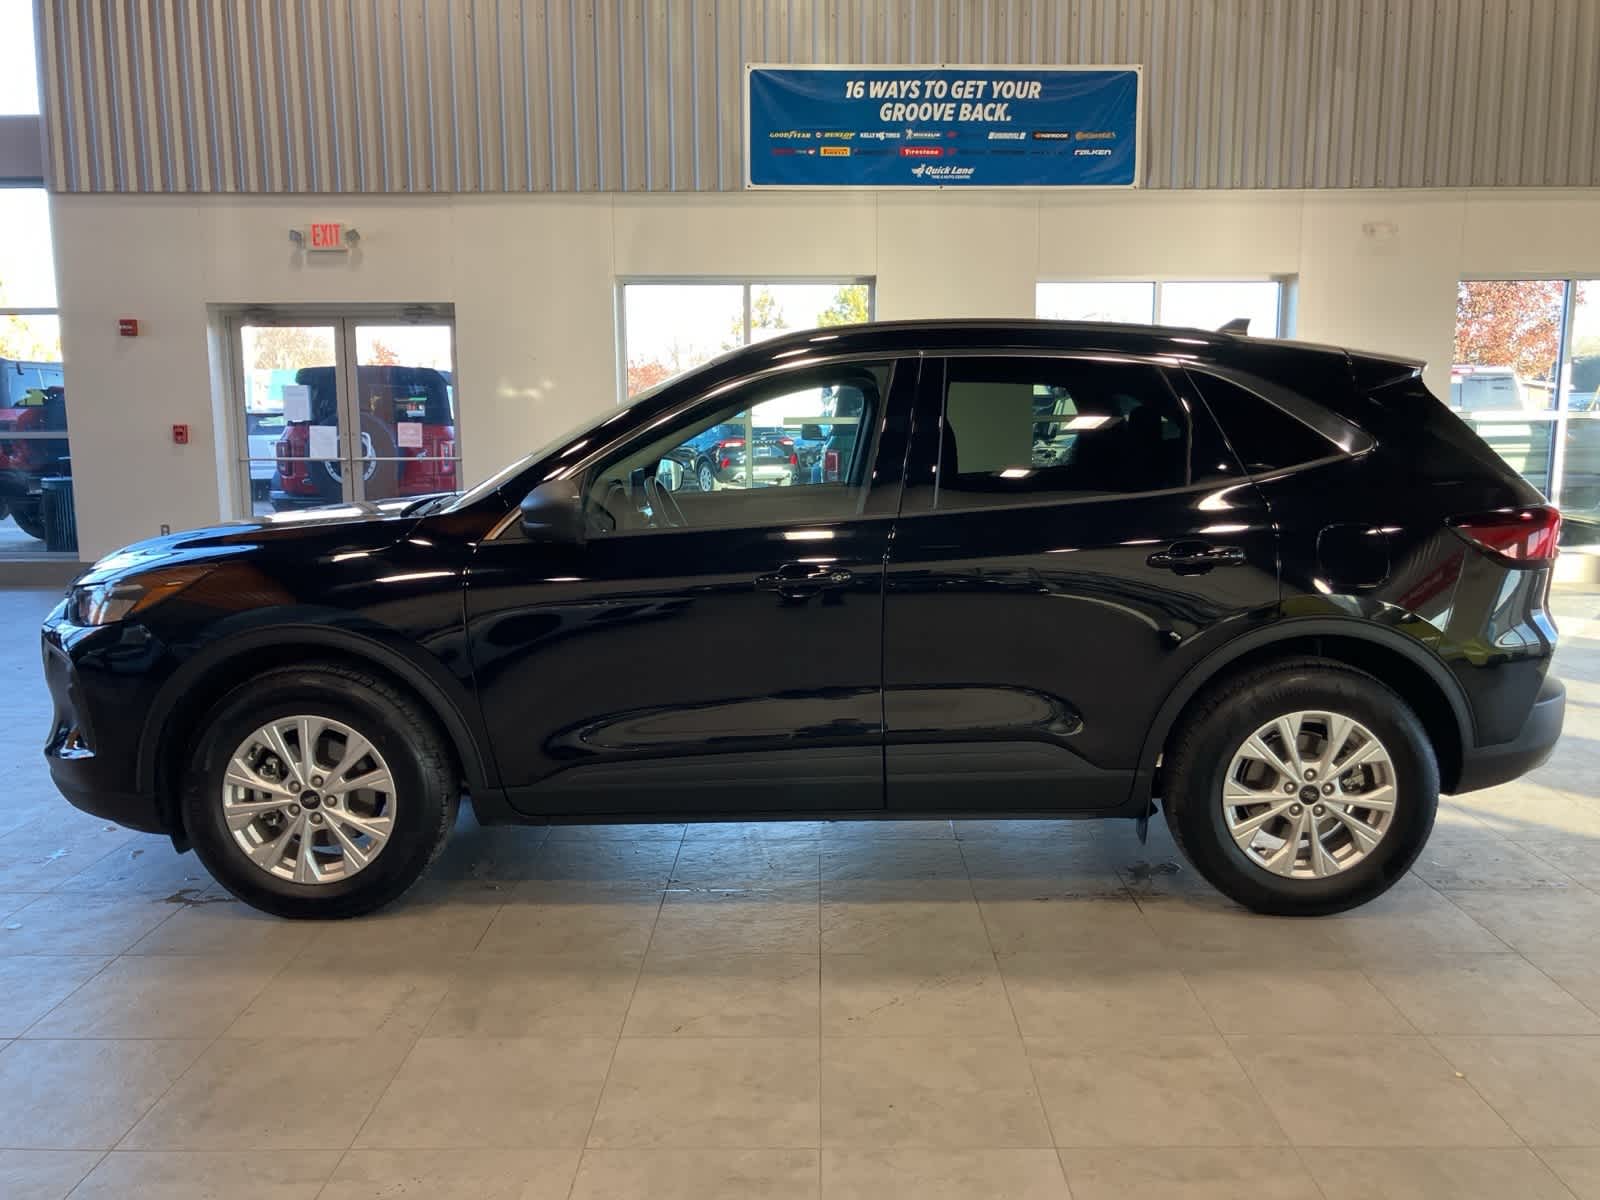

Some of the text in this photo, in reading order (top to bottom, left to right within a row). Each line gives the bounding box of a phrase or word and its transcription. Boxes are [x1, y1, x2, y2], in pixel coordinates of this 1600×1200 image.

[845, 80, 1042, 98] 16 WAYS TO GET YOUR
[879, 102, 1012, 121] GROOVE BACK.
[925, 166, 975, 175] Quick Lane
[311, 223, 341, 248] EXIT
